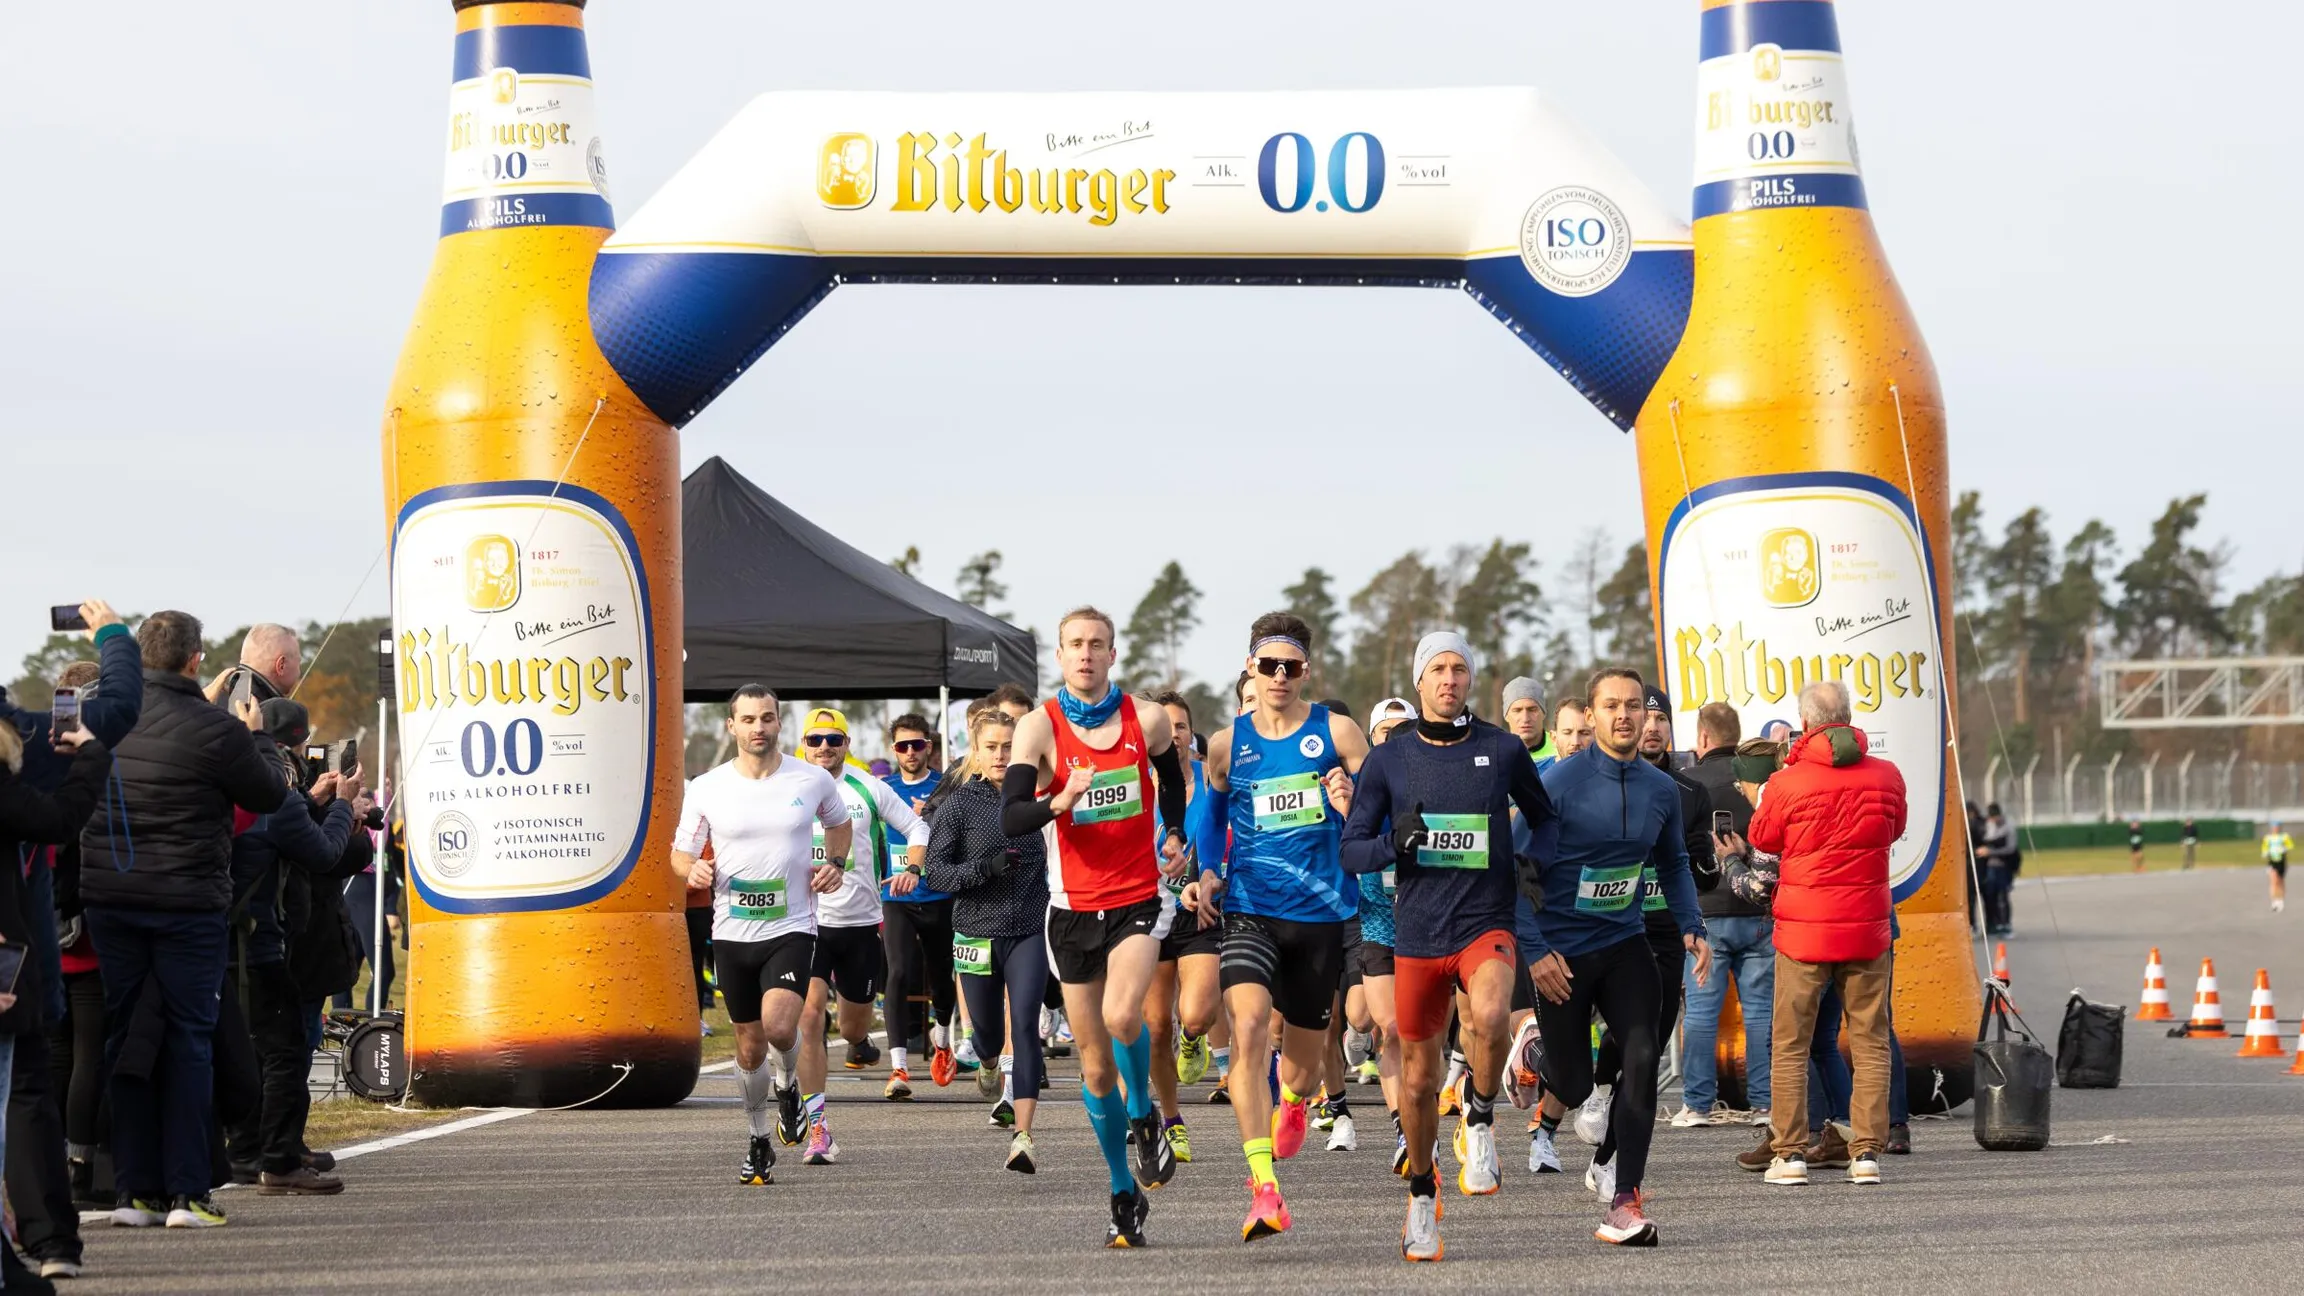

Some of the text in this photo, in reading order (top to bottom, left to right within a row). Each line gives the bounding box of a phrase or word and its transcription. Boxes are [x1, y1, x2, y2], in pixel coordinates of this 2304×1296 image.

[1707, 89, 1833, 129] Biburger
[451, 111, 571, 151] Biurger
[1748, 130, 1795, 160] 0.0
[482, 151, 528, 180] 0.0
[1205, 164, 1238, 178] Alk.
[1257, 132, 1386, 213] 0.0
[889, 131, 1177, 226] Bitburger
[1751, 178, 1795, 197] PILS
[485, 198, 526, 216] PILS
[467, 213, 546, 228] ALKOHOLFREI
[1547, 218, 1606, 248] ISO
[1548, 249, 1605, 261] TONISCH
[531, 550, 560, 561] 1817
[1830, 543, 1859, 554] 1817
[514, 603, 616, 642] Bitte ein Bit
[1815, 598, 1911, 637] Bitte ein Bit
[398, 624, 633, 716] Bitburger
[1674, 621, 1927, 713] Bitburger
[460, 718, 543, 778] 0.0
[1869, 738, 1885, 748] vol
[1065, 757, 1080, 766] LG
[429, 783, 591, 803] PILS ALKOHOLFREI
[1086, 785, 1127, 808] 1999
[1269, 791, 1304, 813] 1021
[1097, 807, 1122, 818] JOSHUA
[1280, 813, 1298, 823] JOSIA
[504, 817, 584, 830] ISOTONISCH
[438, 830, 468, 852] ISO
[505, 832, 606, 845] VITAMINHALTIG
[1432, 832, 1475, 850] 1930
[505, 848, 591, 860] ALKOHOLFREI
[811, 847, 827, 860] 10
[1441, 853, 1465, 862] SIMON
[1592, 881, 1629, 898] 1022
[1645, 882, 1664, 896] 01
[738, 892, 776, 907] 2083
[1592, 898, 1625, 907] ALEXANDER
[953, 946, 978, 962] 2010
[380, 1033, 390, 1086] MYLAPS
